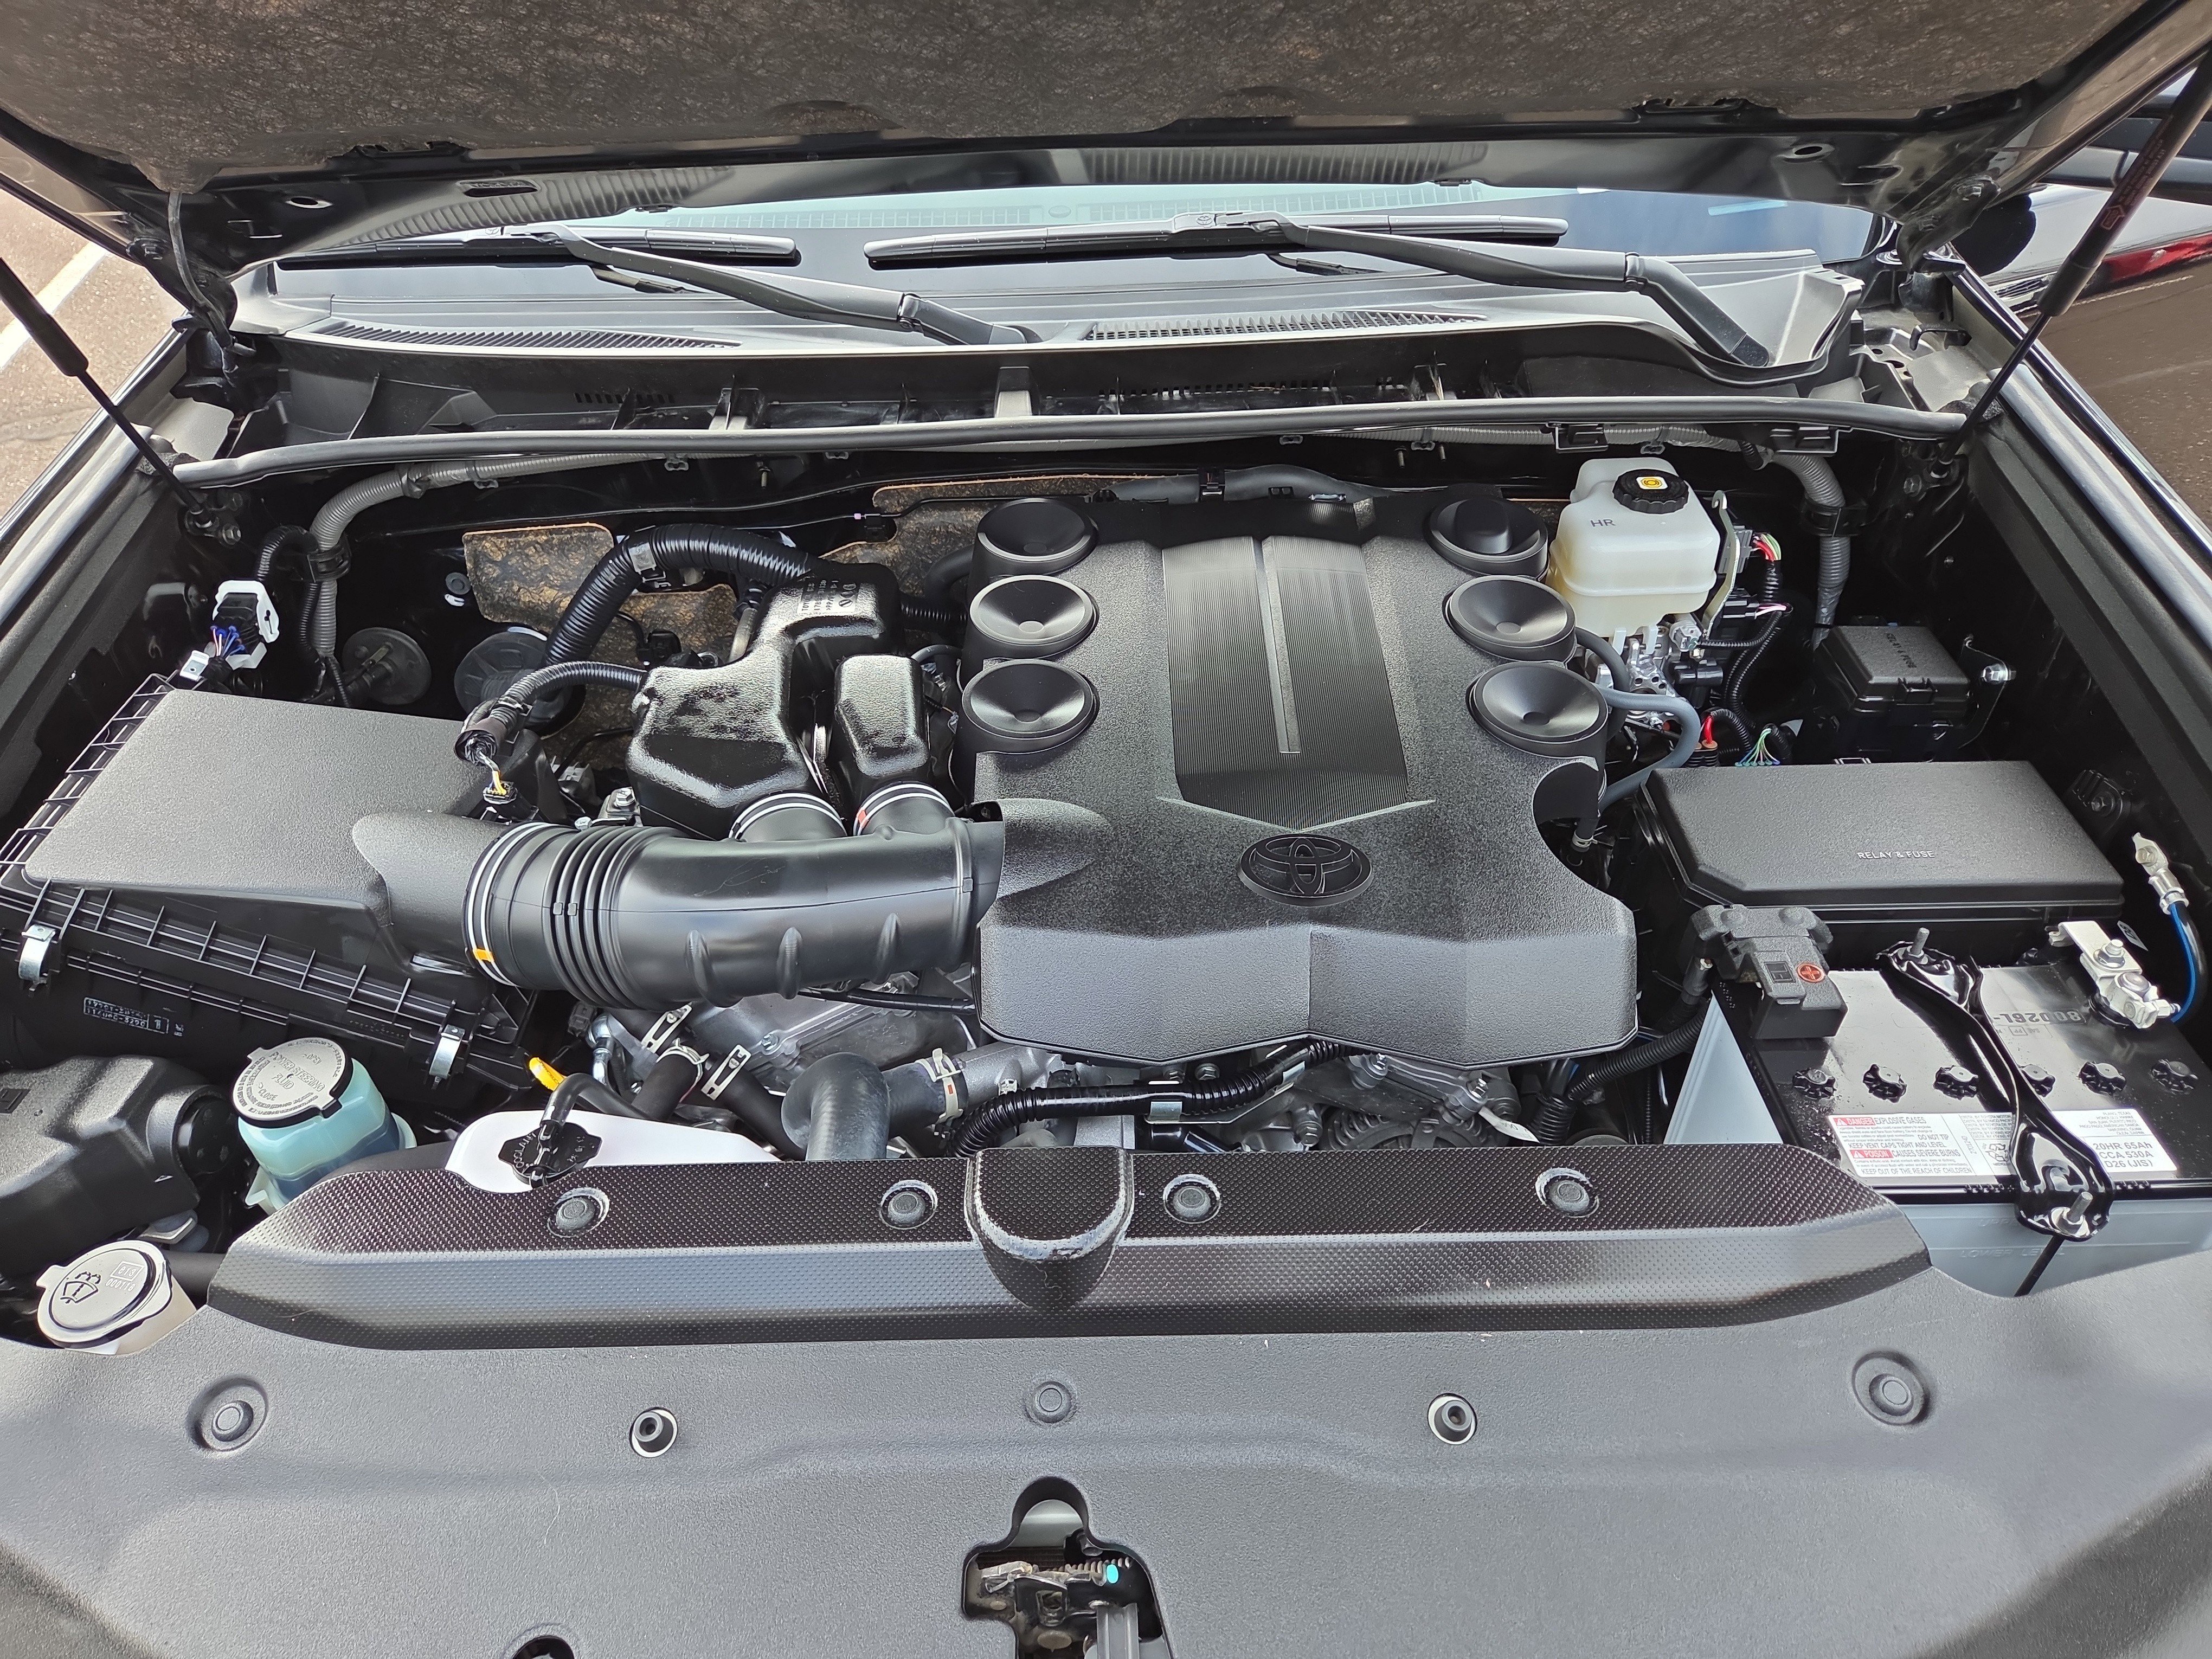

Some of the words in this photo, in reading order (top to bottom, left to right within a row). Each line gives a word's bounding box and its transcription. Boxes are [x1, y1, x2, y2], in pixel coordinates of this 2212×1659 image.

[1590, 519, 1616, 527] HR
[1857, 851, 1893, 859] RELAY
[268, 1051, 295, 1071] POWER
[291, 1066, 325, 1092] STEERING
[258, 1088, 279, 1101] CLOSE
[118, 1266, 137, 1277] e13
